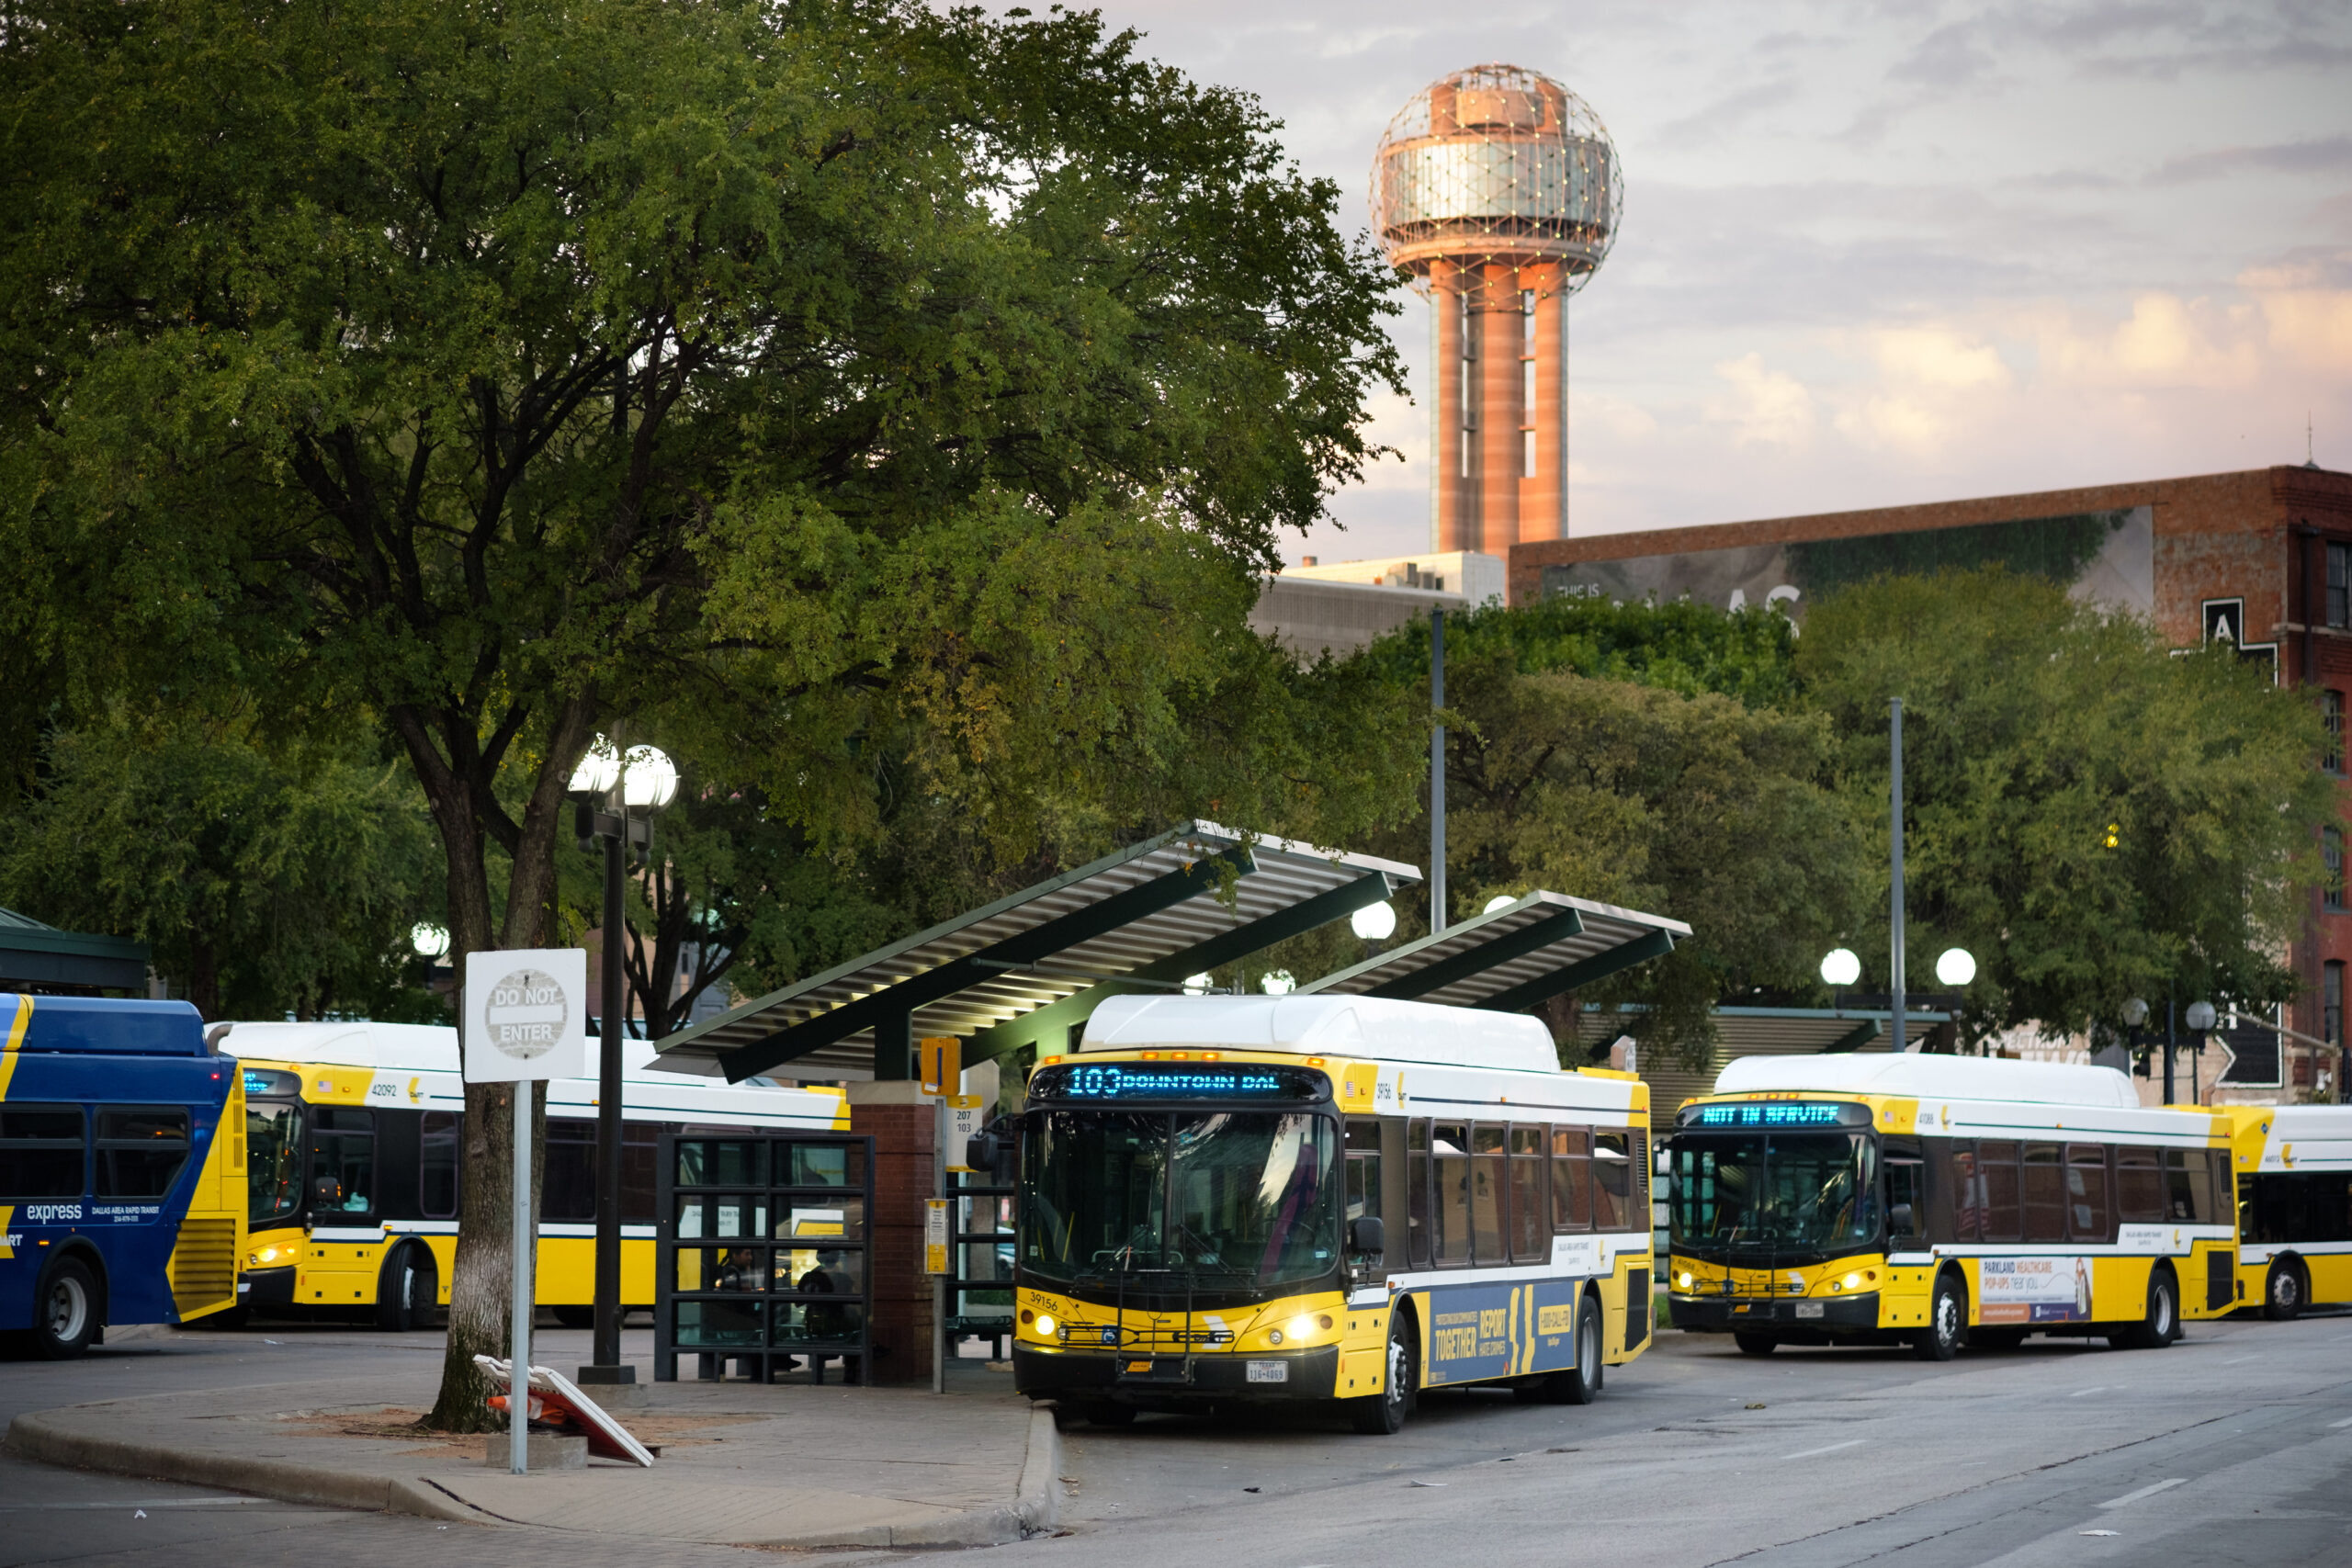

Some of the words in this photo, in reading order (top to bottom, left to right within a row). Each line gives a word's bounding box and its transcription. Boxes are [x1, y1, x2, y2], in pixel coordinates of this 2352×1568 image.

[1588, 583, 1600, 599] IS
[495, 988, 520, 1006] DO
[526, 987, 559, 1005] NOT
[500, 1023, 552, 1042] ENTER
[1069, 1067, 1122, 1095] 103
[1123, 1076, 1235, 1089] DOWNTOWN
[1242, 1076, 1280, 1089] DAL
[371, 1084, 397, 1098] 42092
[1376, 1083, 1392, 1100] 39156
[956, 1111, 971, 1121] 207
[1703, 1107, 1736, 1122] NOT
[1742, 1107, 1760, 1122] IN
[957, 1123, 971, 1133] 103
[27, 1204, 82, 1224] express
[92, 1206, 111, 1214] DALLAS
[111, 1206, 125, 1214] AREA
[1984, 1261, 2016, 1274] PARKLAND
[1029, 1291, 1058, 1312] 39156
[1479, 1308, 1507, 1338] REPORT
[1435, 1326, 1477, 1361] TOGETHER
